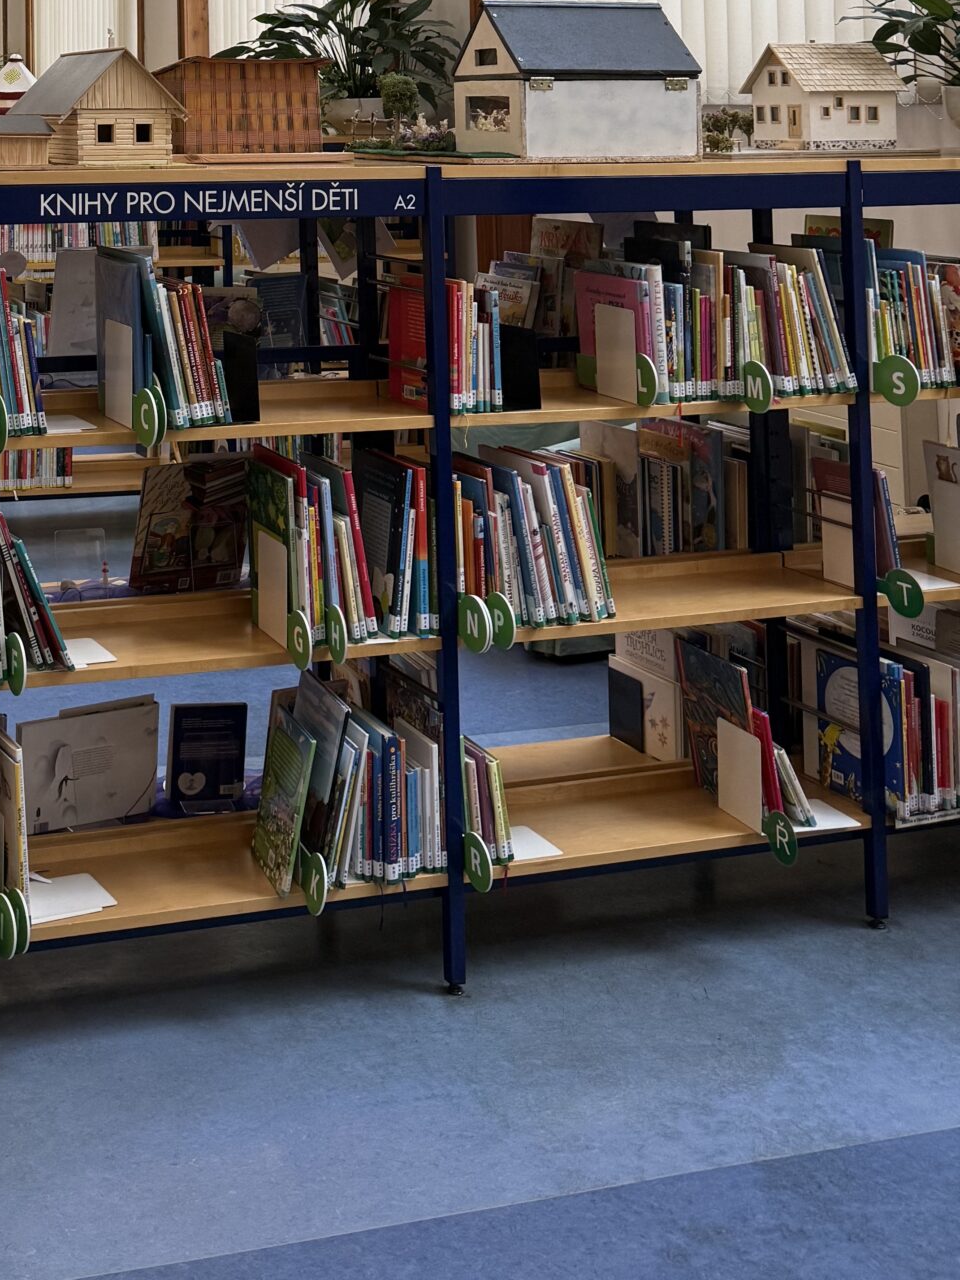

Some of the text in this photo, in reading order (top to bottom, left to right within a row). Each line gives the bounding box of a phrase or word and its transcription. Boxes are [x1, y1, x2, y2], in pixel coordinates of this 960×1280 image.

[40, 182, 416, 217] KNIHY PRO NEJMENŠÍ DĚTI A2
[654, 280, 666, 376] JOSEF LADA DĚTEM
[747, 376, 764, 401] M
[892, 371, 906, 395] S
[141, 404, 148, 430] C
[896, 581, 912, 607] T
[466, 610, 478, 638] N
[494, 609, 504, 634] P
[911, 623, 936, 637] KOCOU
[294, 626, 303, 653] G
[332, 621, 340, 651] H
[12, 648, 18, 675] F
[389, 755, 397, 803] kulihráška
[776, 820, 790, 855] Ř
[470, 847, 482, 877] R
[310, 871, 318, 900] K
